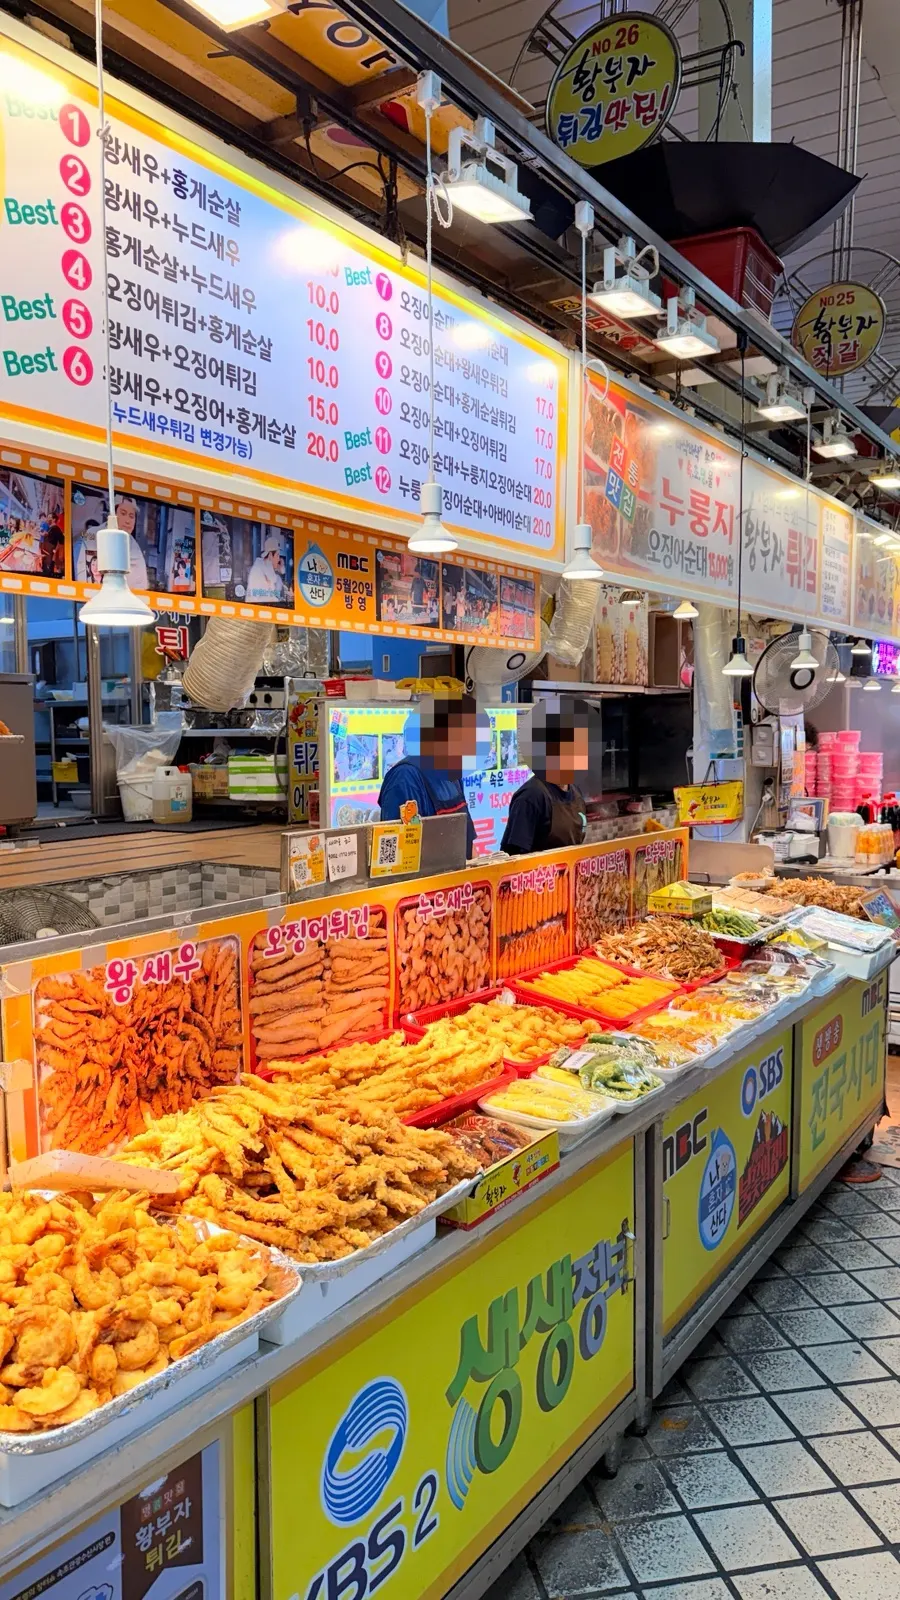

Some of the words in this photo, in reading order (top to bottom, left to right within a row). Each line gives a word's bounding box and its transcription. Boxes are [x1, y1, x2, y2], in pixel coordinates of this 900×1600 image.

[592, 39, 611, 56] NO
[615, 24, 639, 50] 26
[558, 49, 656, 102] 황부자
[4, 198, 58, 225] Best
[105, 225, 257, 314] 홍게순살+누드새우
[345, 267, 372, 286] Best
[307, 281, 339, 314] 10.0
[820, 297, 834, 307] NO
[837, 291, 855, 306] 25
[107, 273, 273, 362] 오징어튀김+홍게순살
[800, 307, 878, 344] 황부자
[1, 293, 57, 321] Best
[103, 319, 257, 396] 왕새우+오징어튀김
[307, 319, 339, 351] 10.0
[4, 346, 58, 376] Best
[307, 357, 338, 388] 10.0
[307, 395, 338, 425] 15.0
[536, 397, 553, 420] 17.0
[200, 427, 253, 459] 변경가능)
[307, 432, 338, 463] 20.0
[344, 427, 372, 450] Best
[535, 427, 553, 449] 17.0
[535, 457, 552, 479] 17.0
[345, 462, 372, 486] Best
[399, 475, 531, 533] 누룽징어순대+아바이순대
[534, 488, 551, 508] 20.0
[659, 477, 734, 545] 누룽지
[533, 517, 551, 537] 20.0
[307, 558, 317, 572] 나
[337, 552, 368, 572] MBC
[648, 529, 707, 578] 오징어순대
[786, 528, 817, 594] 튀김
[306, 574, 321, 585] 혼자
[309, 587, 325, 601] 산다
[417, 883, 473, 922] 누드새우
[263, 906, 368, 957] 오징어튀김
[107, 943, 199, 1003] 왕새우
[862, 977, 883, 1017] MBC
[759, 1051, 783, 1100] SBS
[809, 1020, 879, 1151] 전국시대
[709, 1158, 720, 1187] 나
[710, 1203, 726, 1237] 산다
[136, 1497, 192, 1549] 황부자
[415, 1475, 438, 1545] 2
[145, 1530, 183, 1572] 튀김
